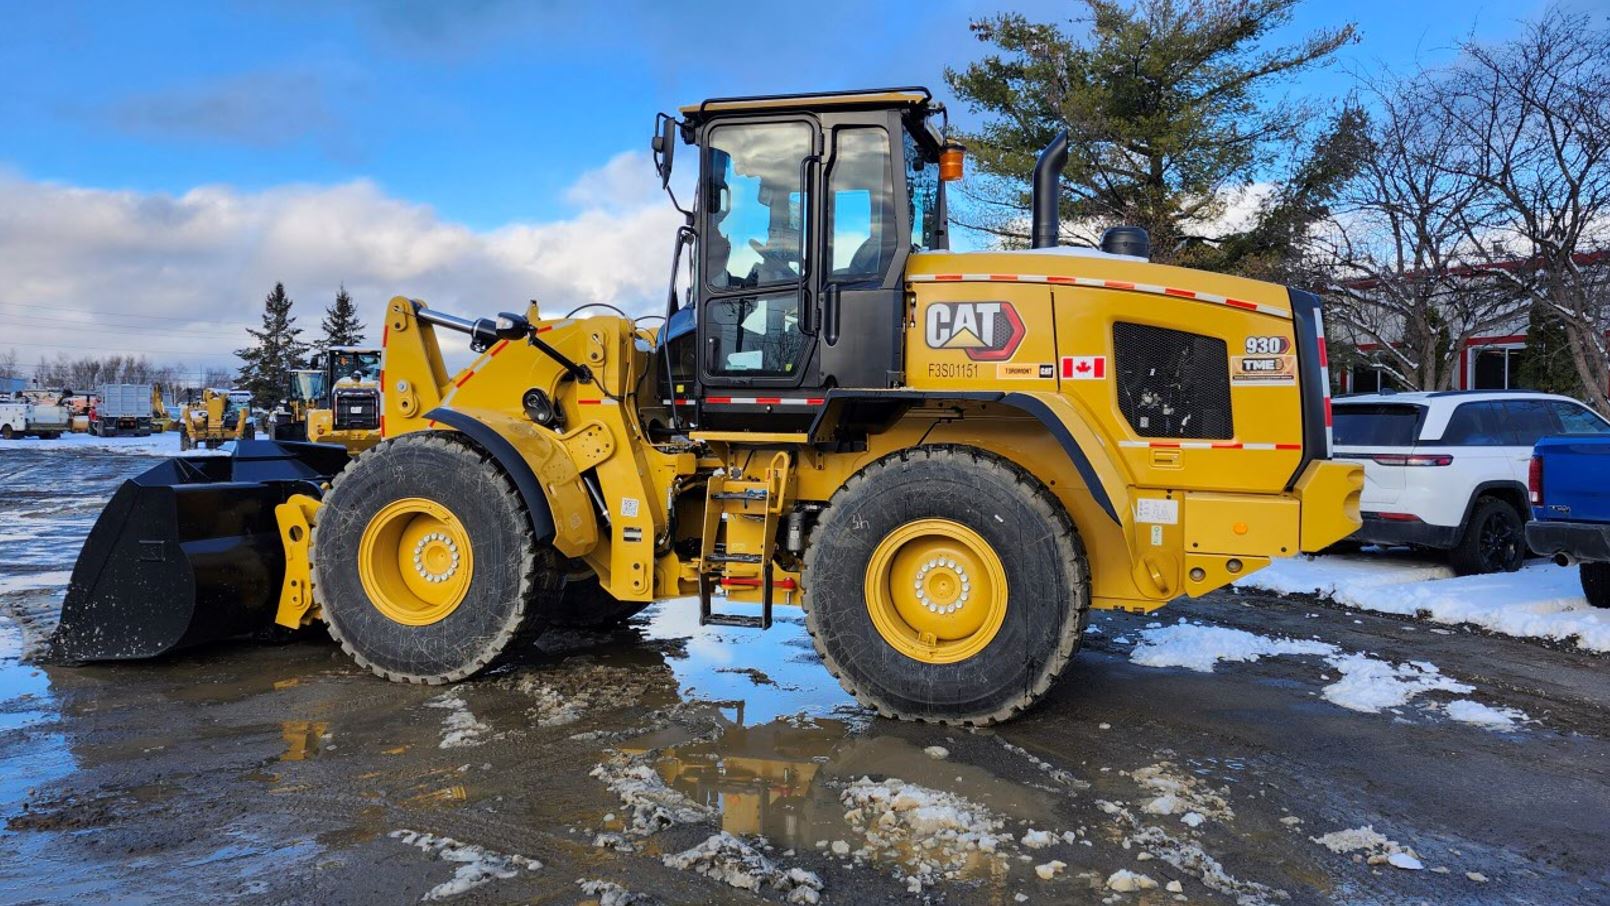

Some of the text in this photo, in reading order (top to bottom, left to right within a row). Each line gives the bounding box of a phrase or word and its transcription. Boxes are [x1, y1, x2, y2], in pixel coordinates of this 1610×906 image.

[927, 303, 1001, 348] CAT
[1246, 336, 1281, 355] 930
[928, 363, 979, 378] F3S01151
[1243, 359, 1275, 370] TME
